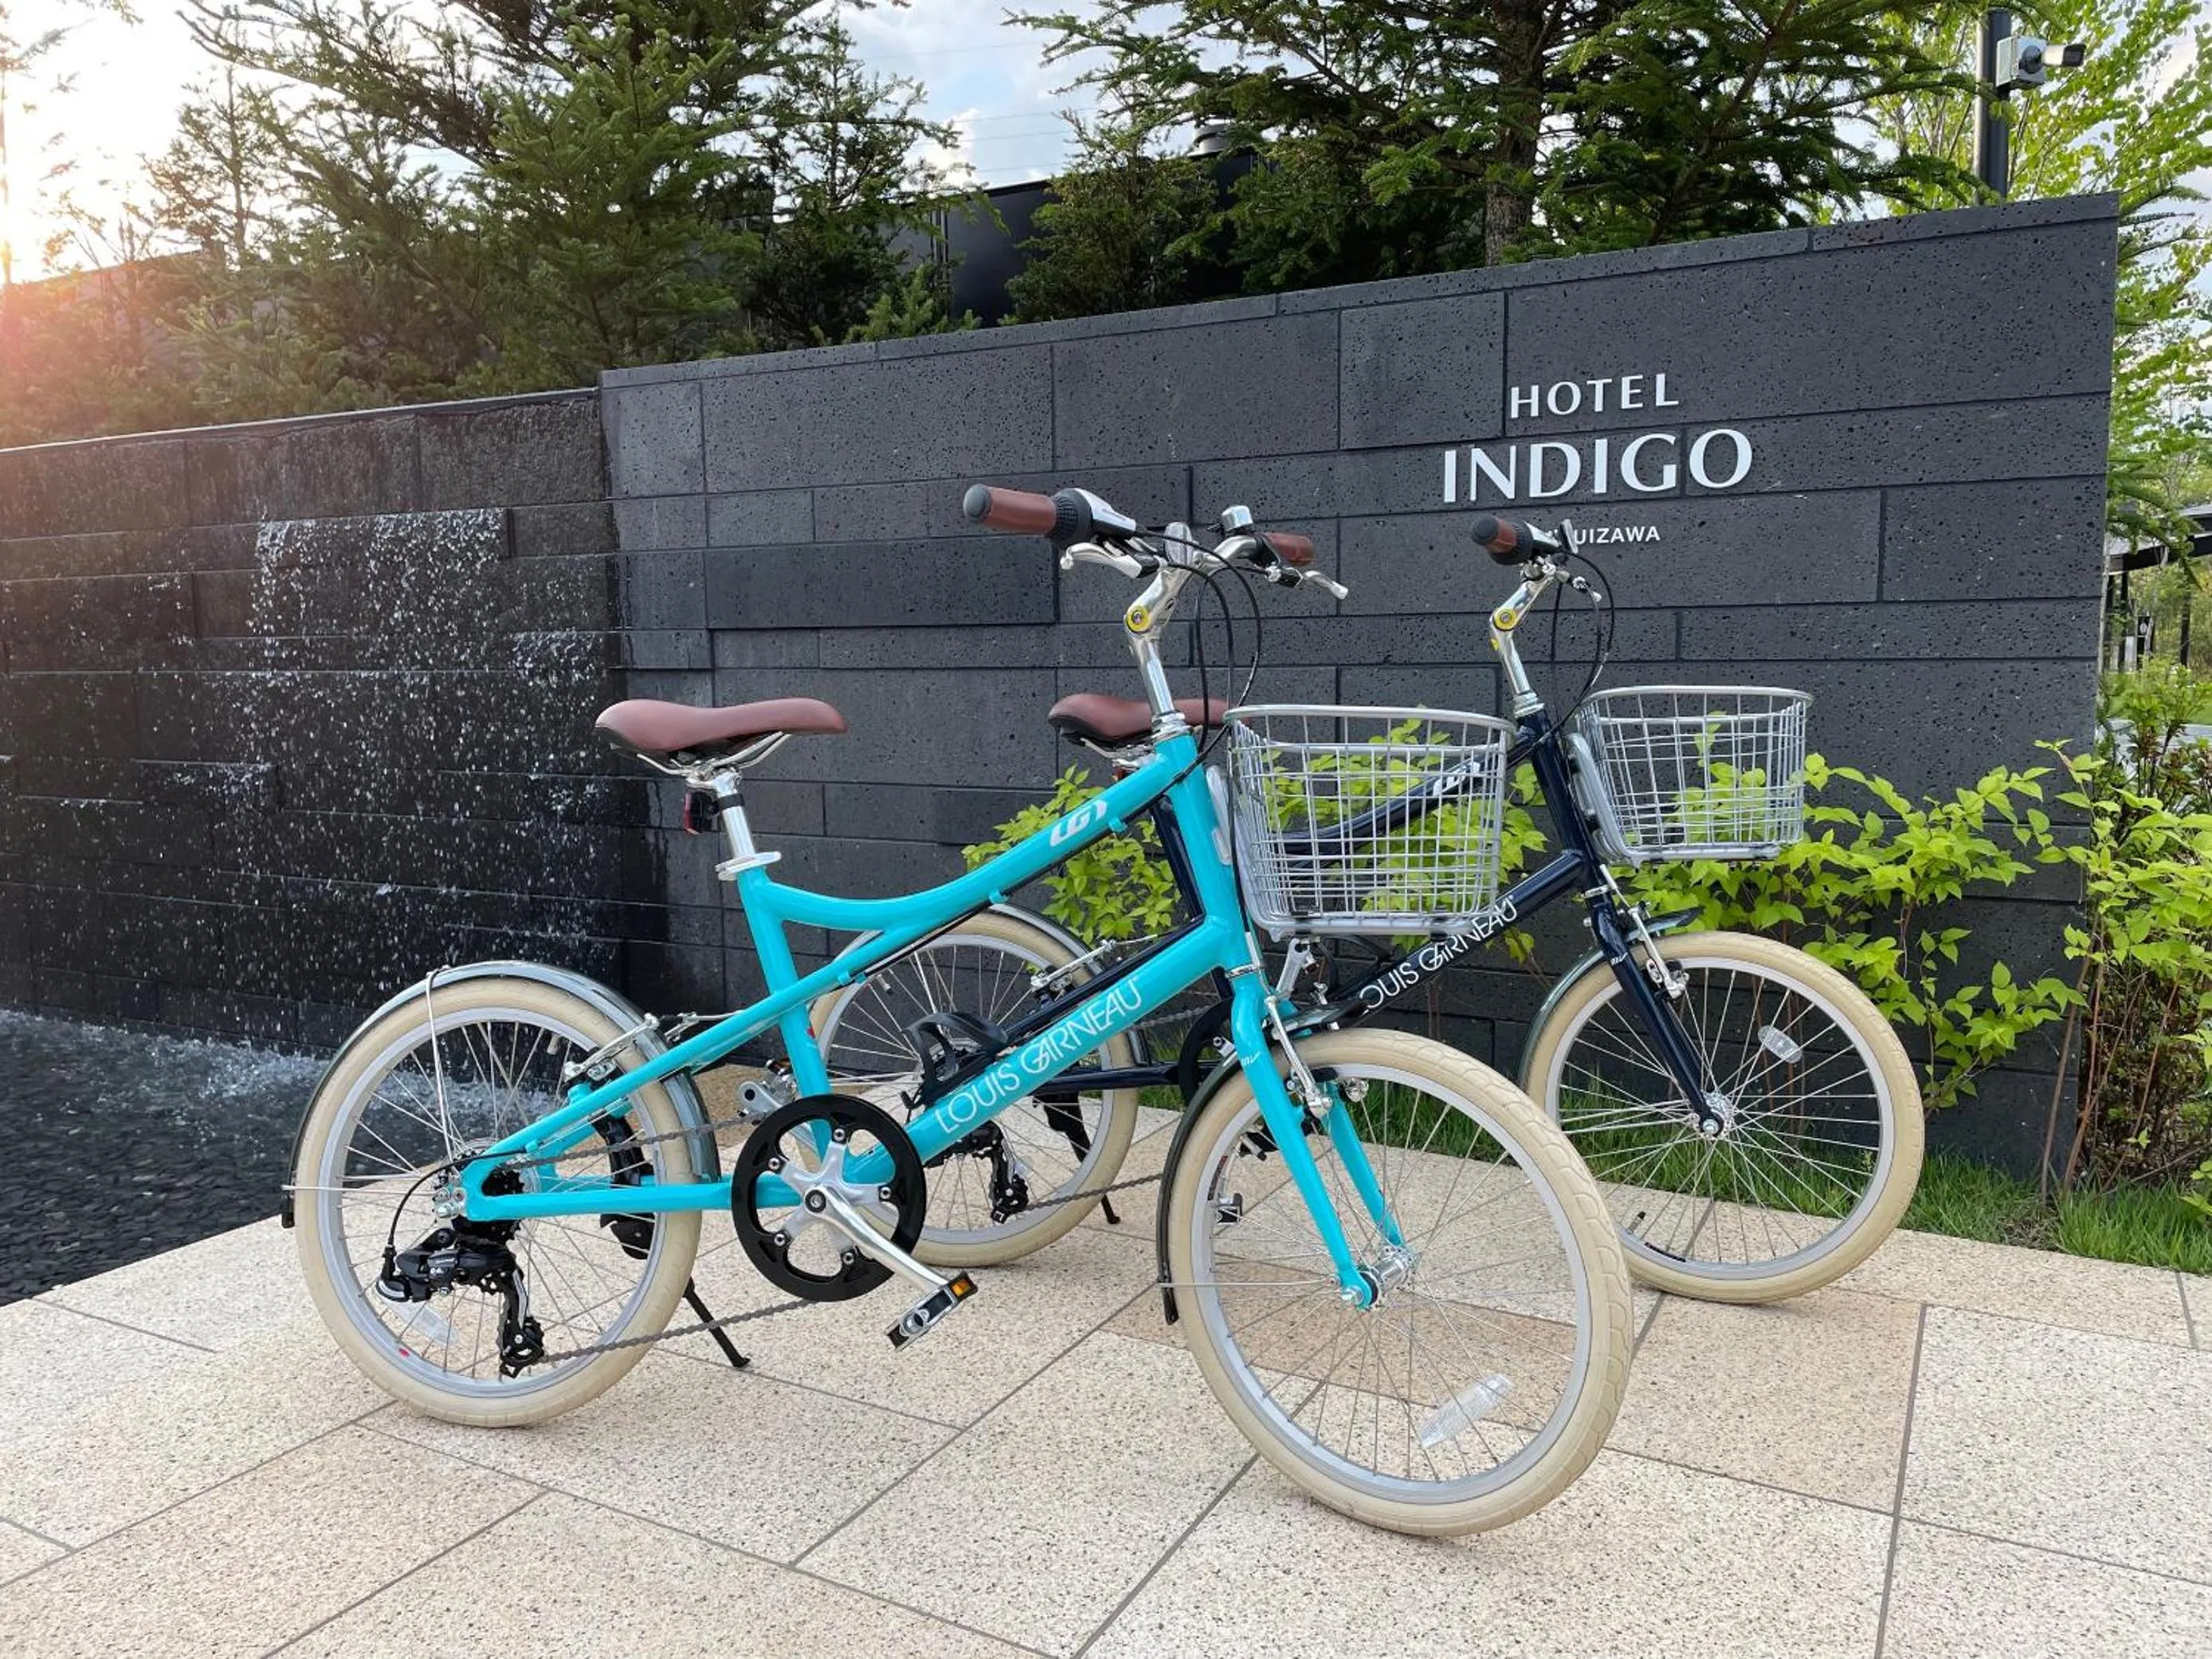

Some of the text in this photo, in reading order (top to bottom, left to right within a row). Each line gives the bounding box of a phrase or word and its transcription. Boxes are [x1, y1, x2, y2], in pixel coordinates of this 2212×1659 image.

[1510, 372, 1679, 419] HOTEL
[1443, 428, 1753, 504] INDIGO
[1544, 526, 1661, 545] UIZAWA
[1359, 963, 1419, 1017] OUIS
[935, 975, 1143, 1134] LOUIS GARNEAU
